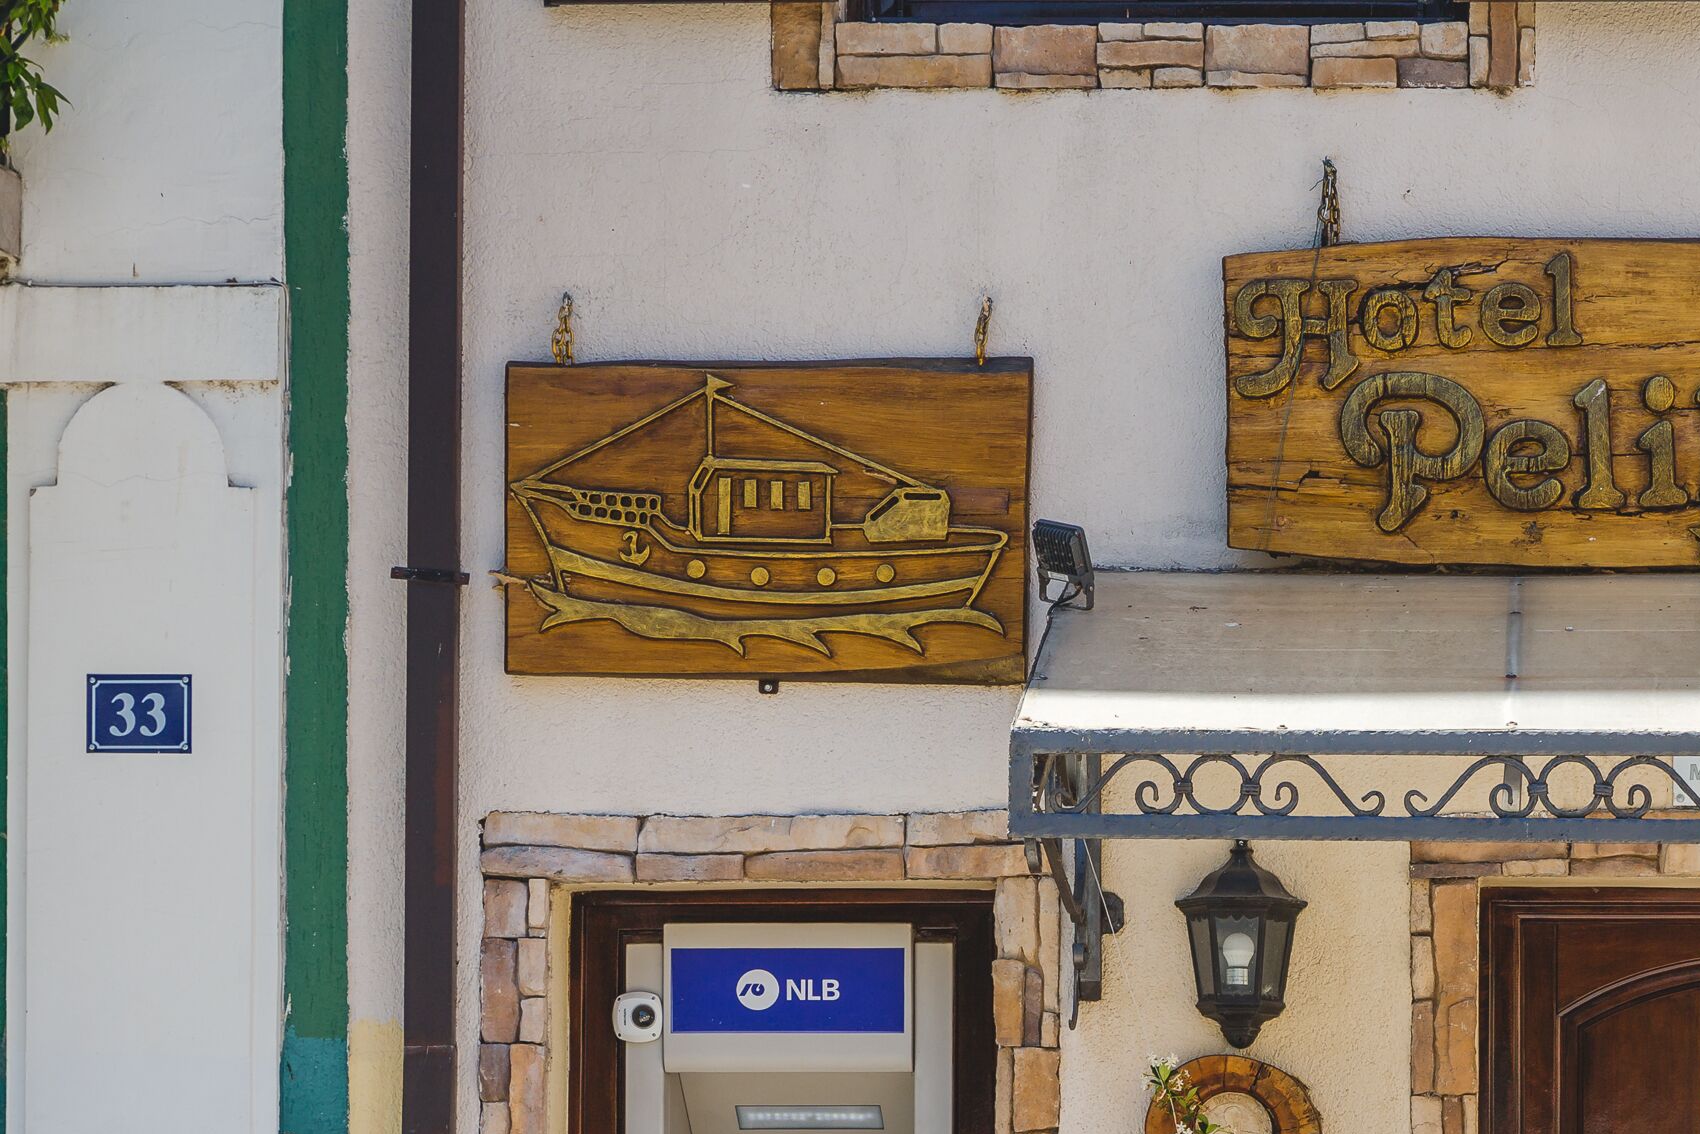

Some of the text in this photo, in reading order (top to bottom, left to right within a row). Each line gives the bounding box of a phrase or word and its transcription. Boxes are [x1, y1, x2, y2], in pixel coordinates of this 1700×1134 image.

[1234, 253, 1584, 398] Hotel
[109, 692, 166, 737] 33
[786, 979, 840, 1001] NLB
